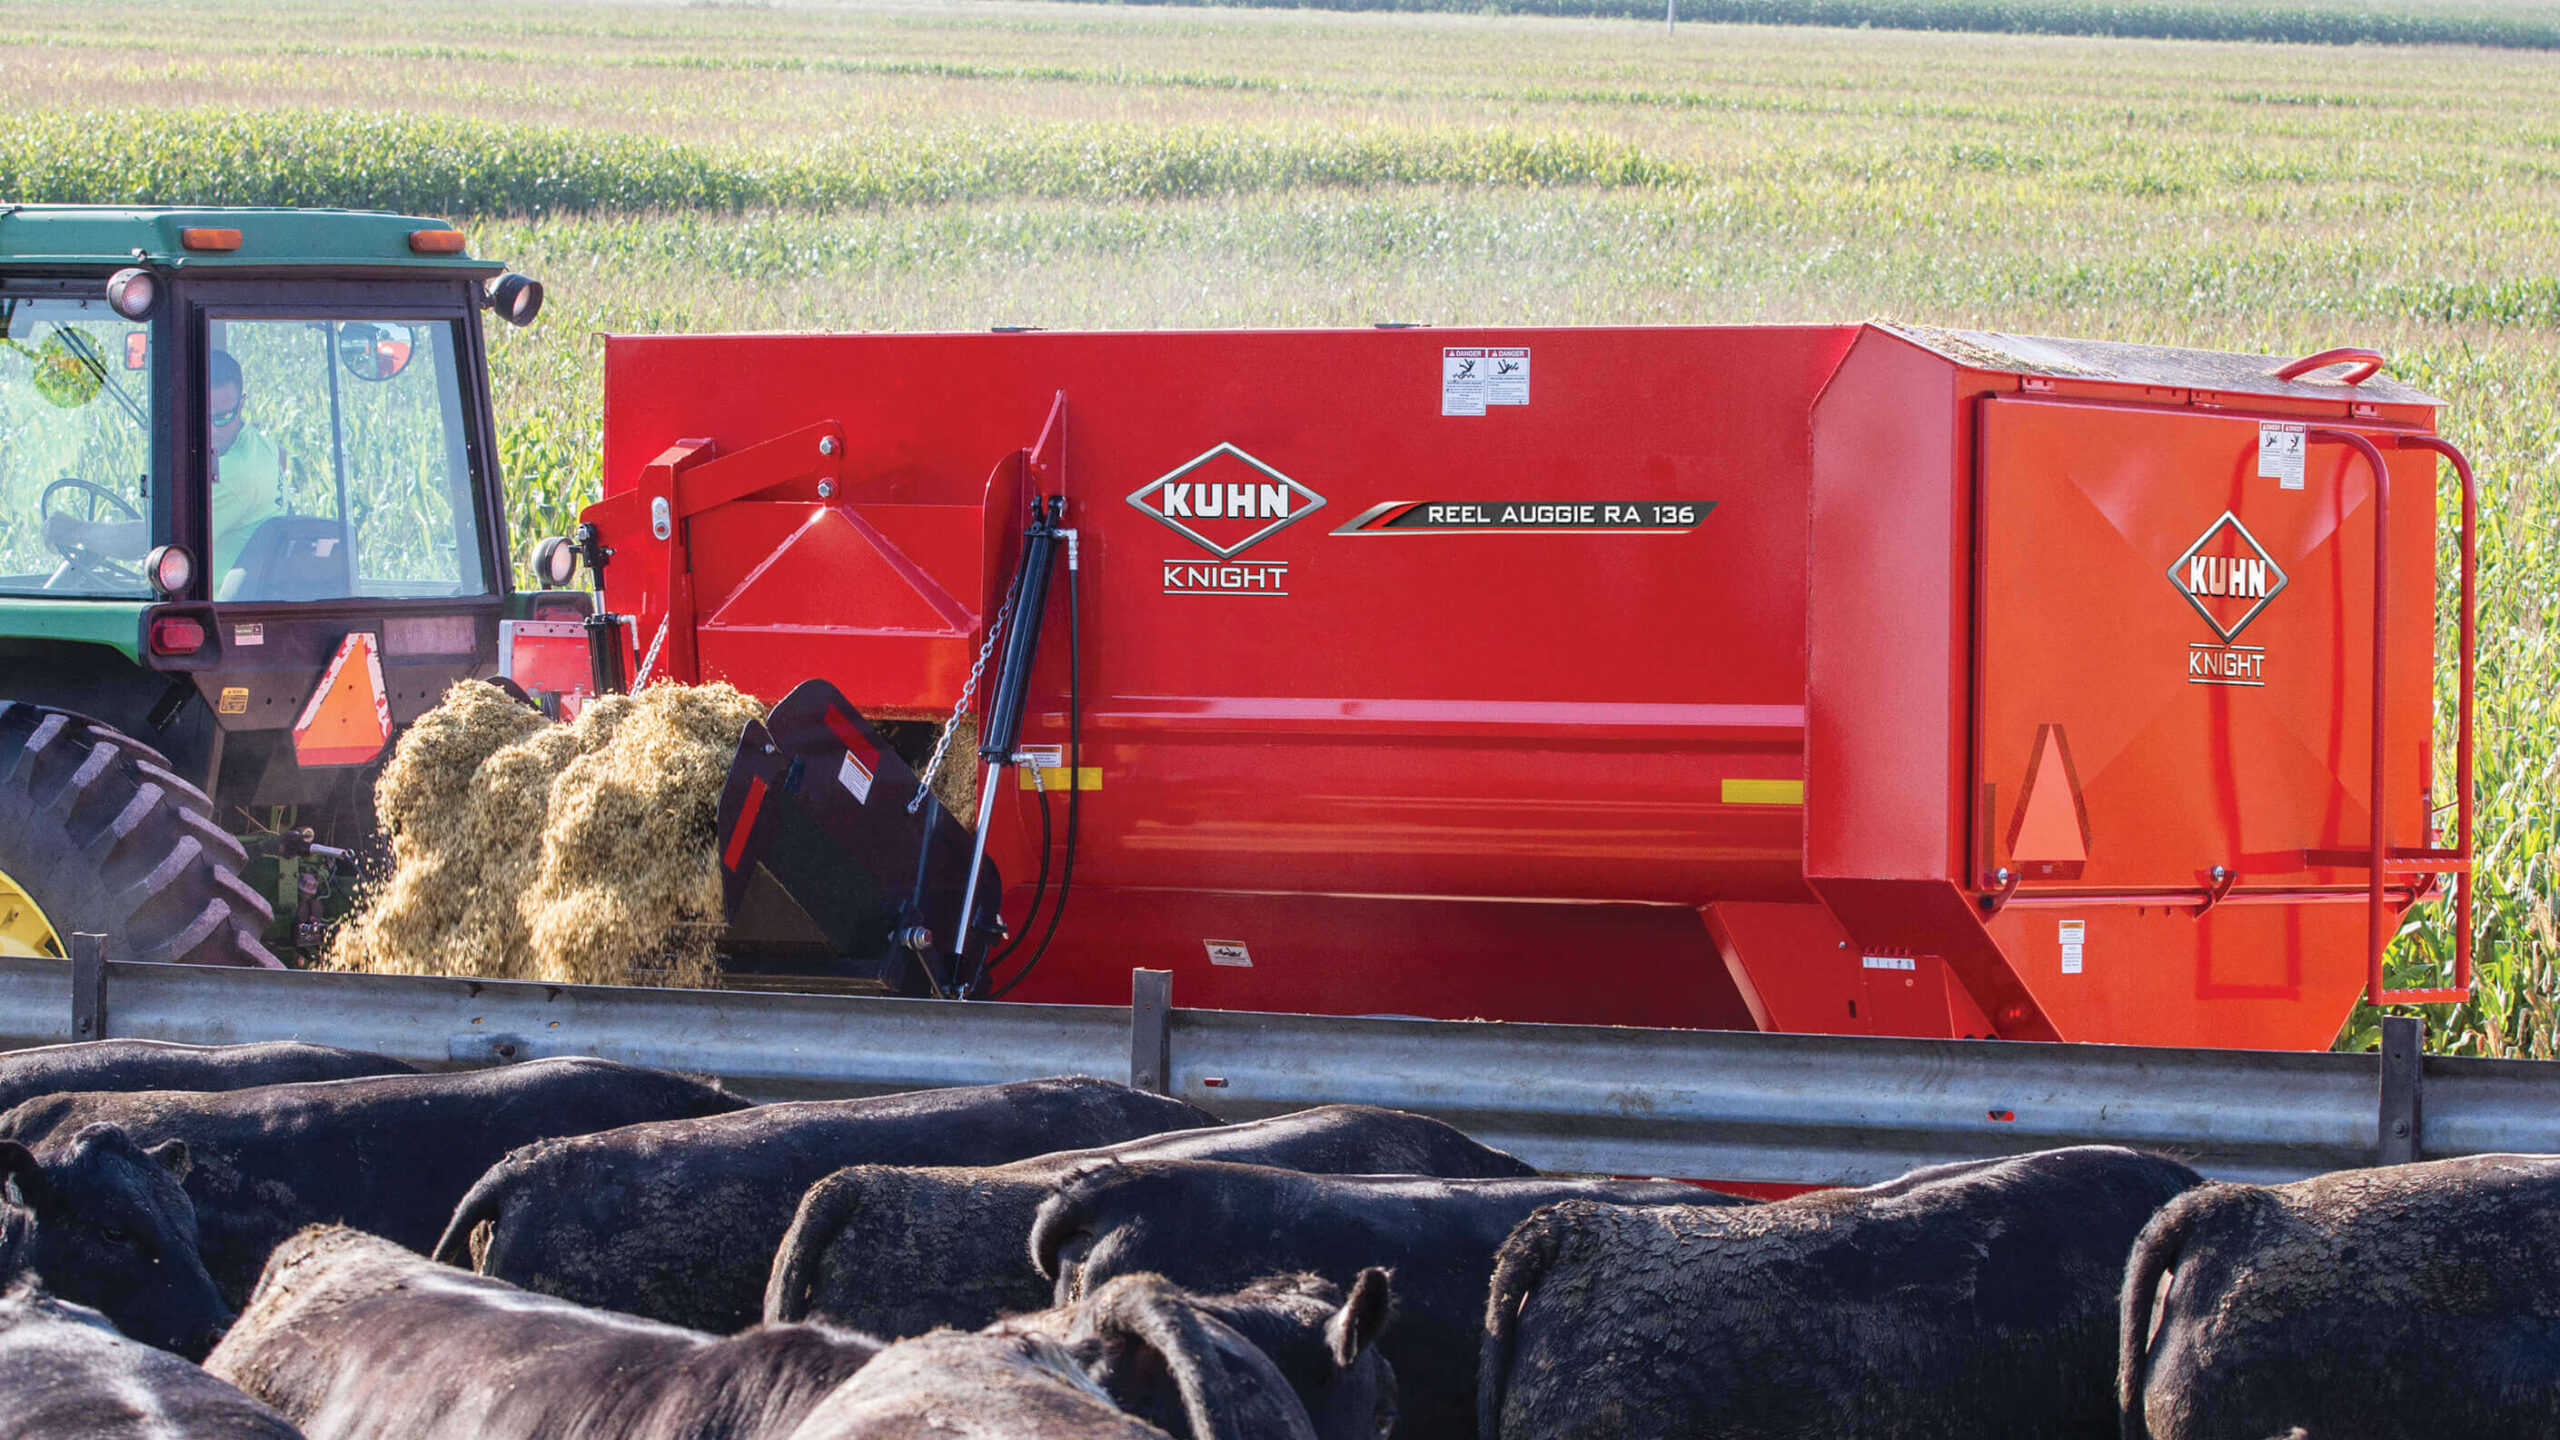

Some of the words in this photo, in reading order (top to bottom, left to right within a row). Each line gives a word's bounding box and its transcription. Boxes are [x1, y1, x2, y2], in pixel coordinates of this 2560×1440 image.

[1162, 482, 1290, 519] KUHN
[1428, 505, 1491, 523] REEL
[1500, 505, 1595, 524] AUGGIE
[1604, 505, 1642, 523] RA
[1652, 505, 1696, 524] 136
[1162, 565, 1289, 589] KNIGHT
[2189, 555, 2266, 599] KUHN
[2189, 650, 2265, 678] KNIGHT
